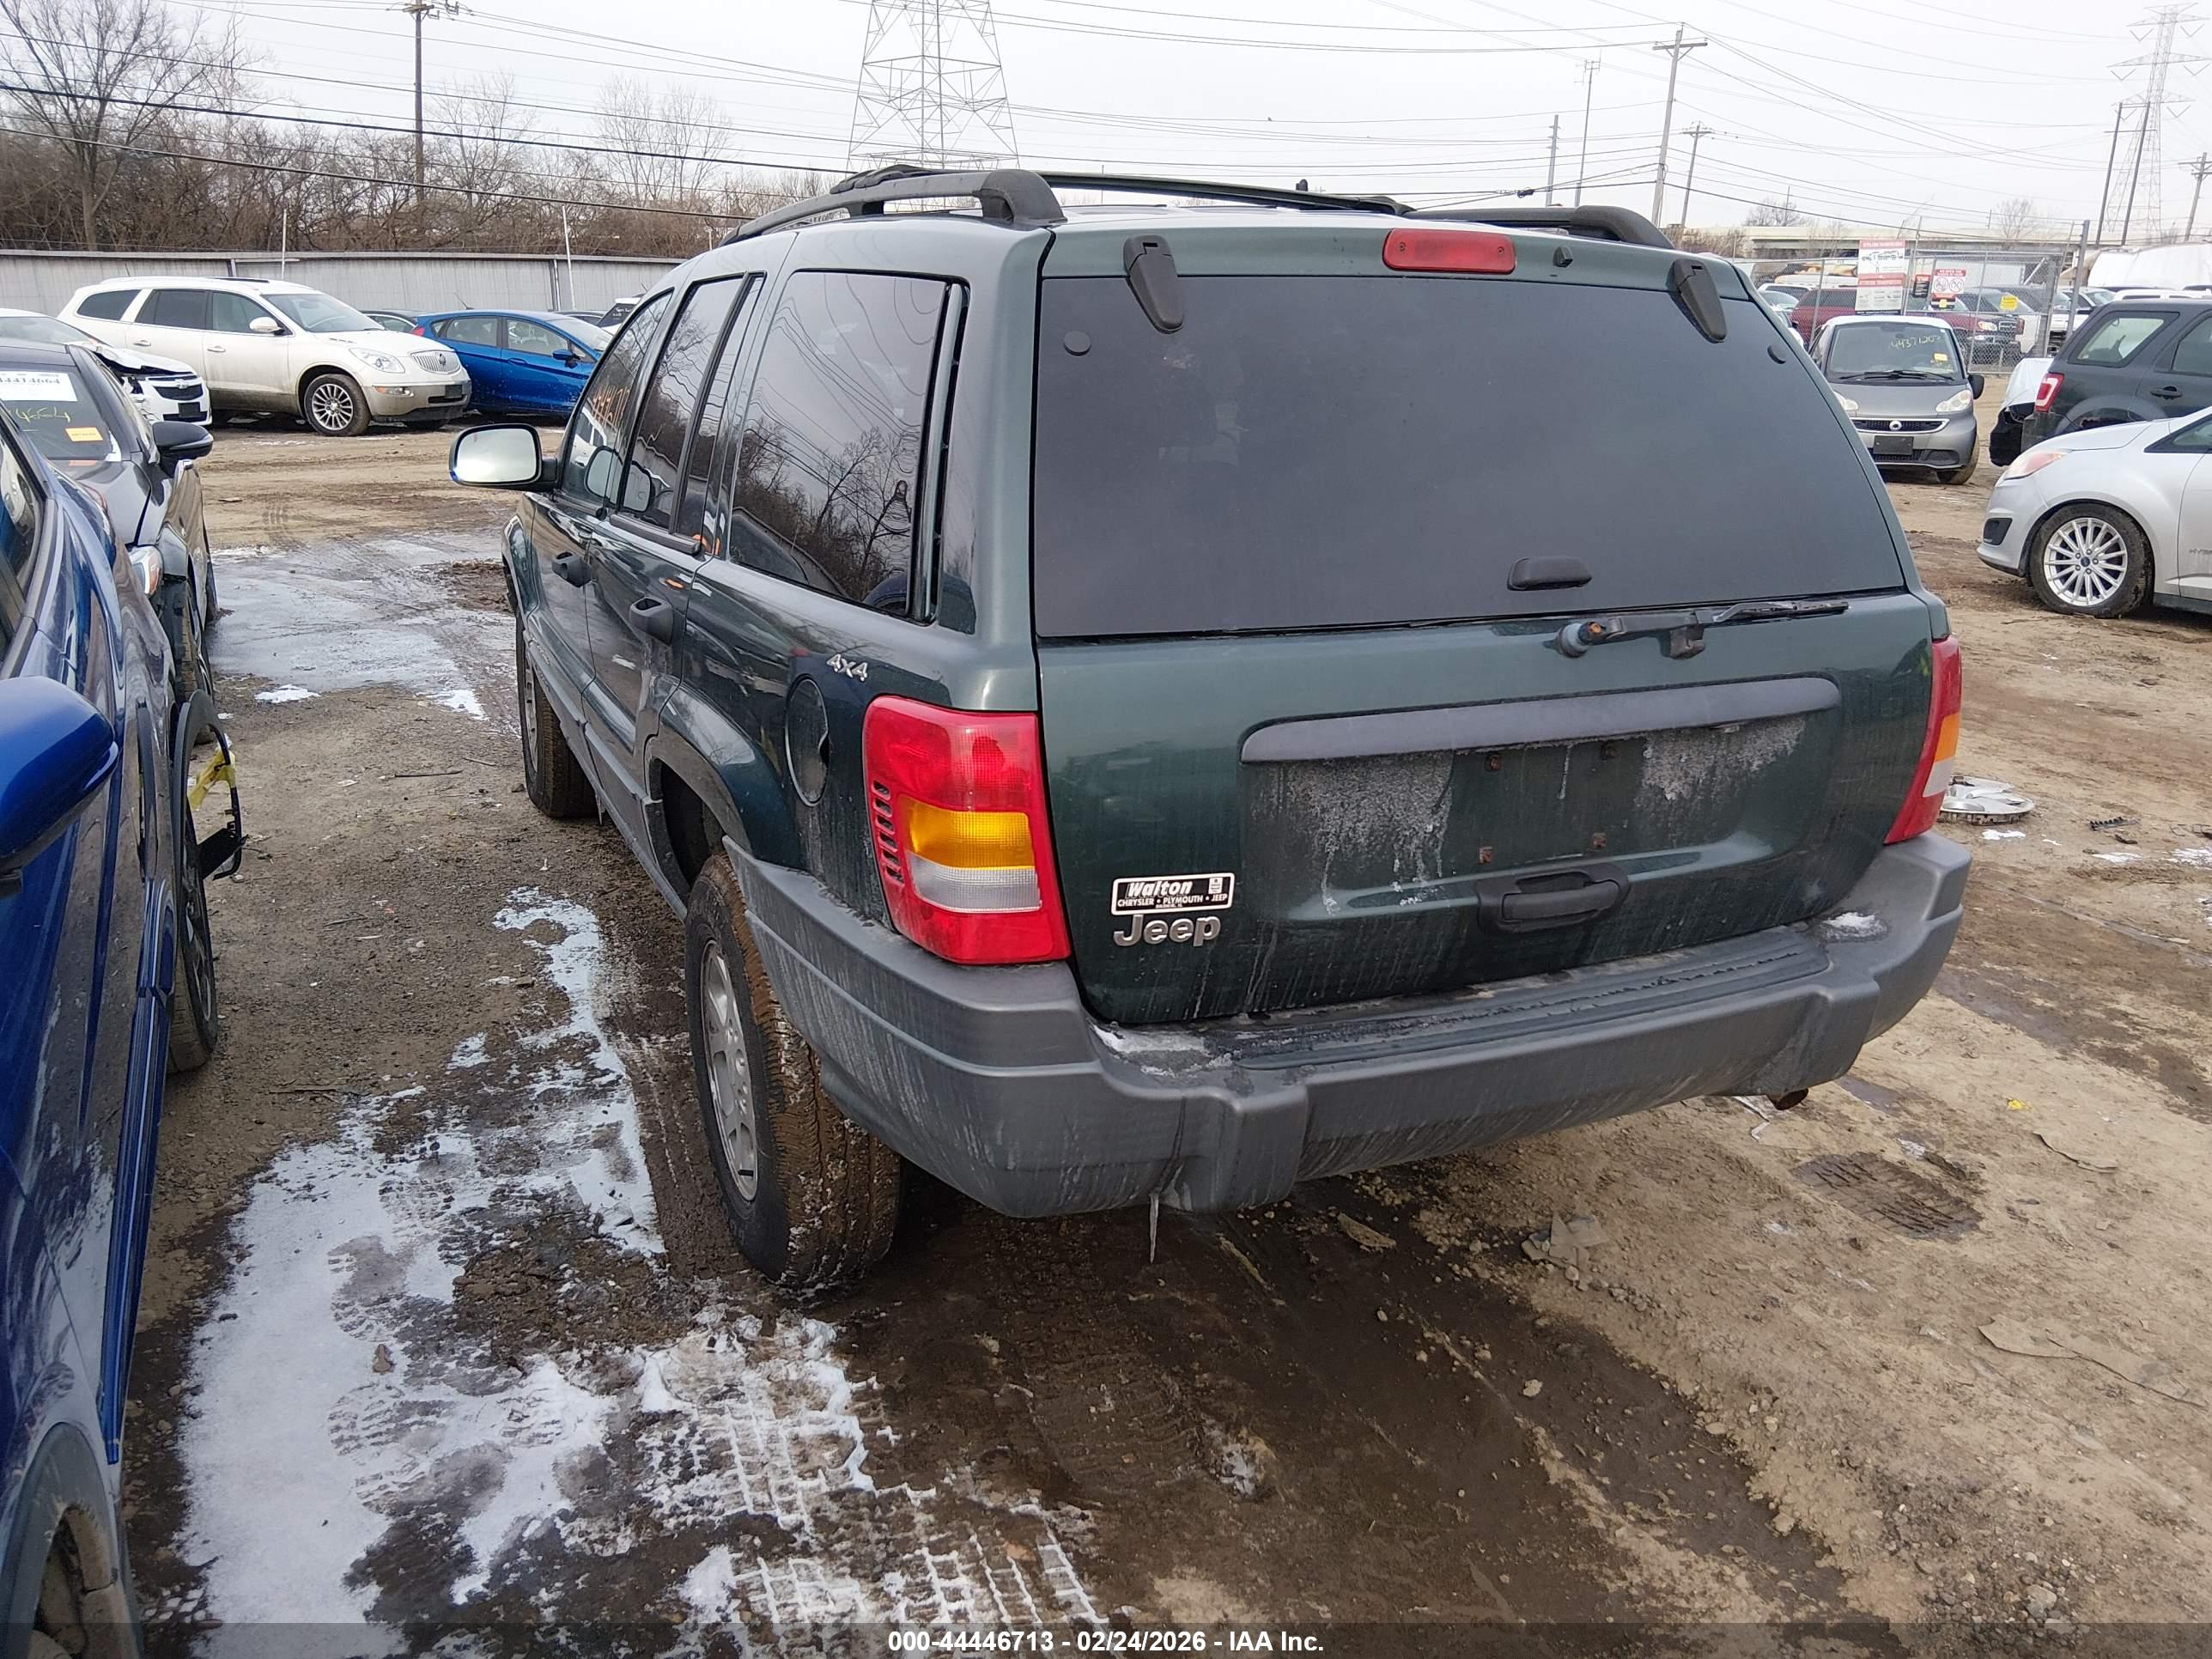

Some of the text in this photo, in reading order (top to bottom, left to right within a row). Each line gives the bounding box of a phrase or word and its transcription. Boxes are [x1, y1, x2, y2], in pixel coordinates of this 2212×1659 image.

[1126, 880, 1194, 898] Walton
[1117, 897, 1155, 908] CHRYSLER
[1162, 895, 1204, 905] PLYMOUTH
[1211, 893, 1229, 902] JEEP
[1113, 914, 1222, 947] Jeep
